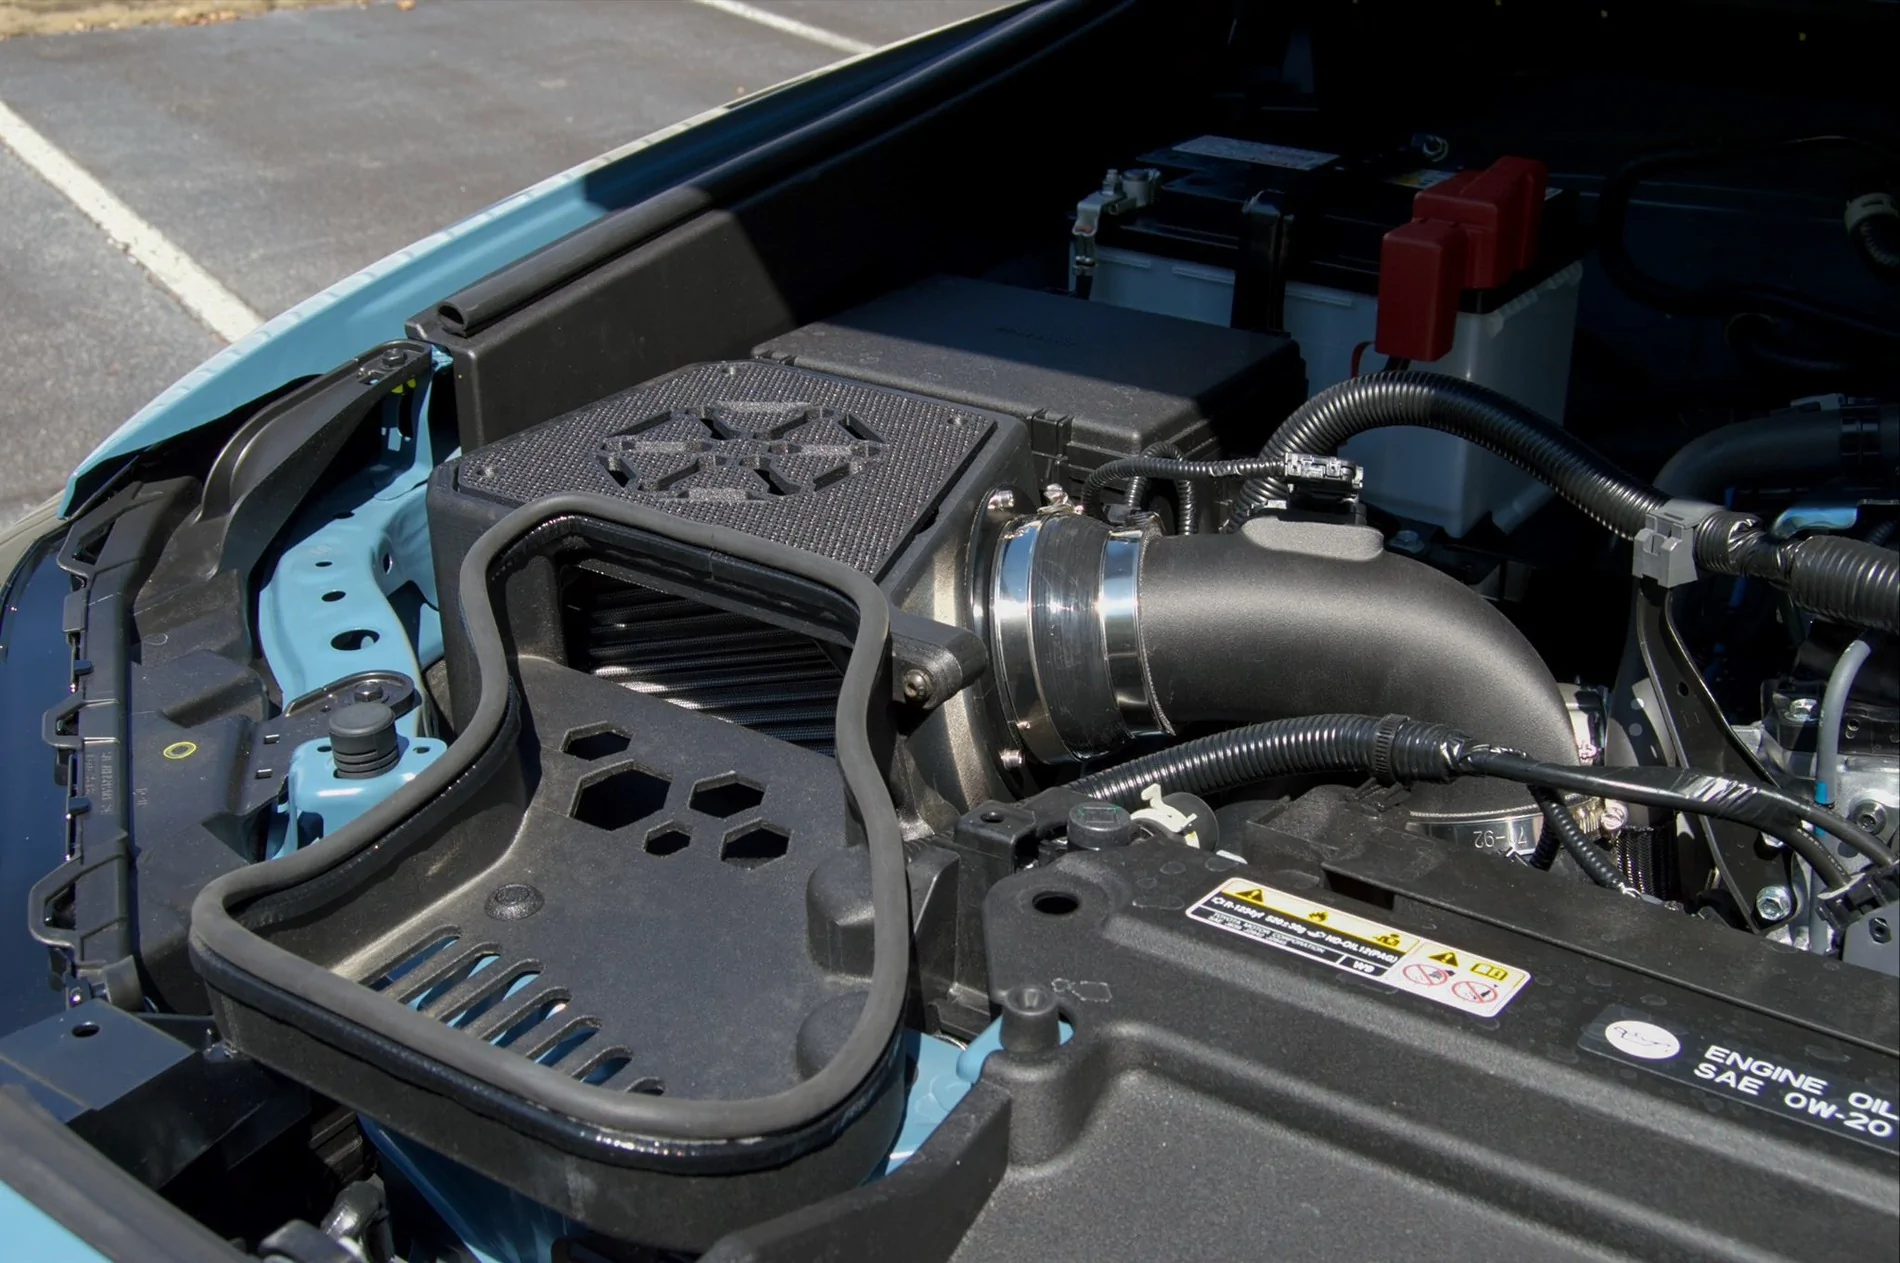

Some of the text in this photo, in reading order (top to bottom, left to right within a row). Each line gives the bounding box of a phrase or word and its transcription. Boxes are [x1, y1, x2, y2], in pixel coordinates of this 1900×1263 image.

[1213, 912, 1242, 925] TOYOTA
[1693, 1062, 1893, 1138] SAE 0W-20
[1703, 1044, 1899, 1121] ENGINE OIL
